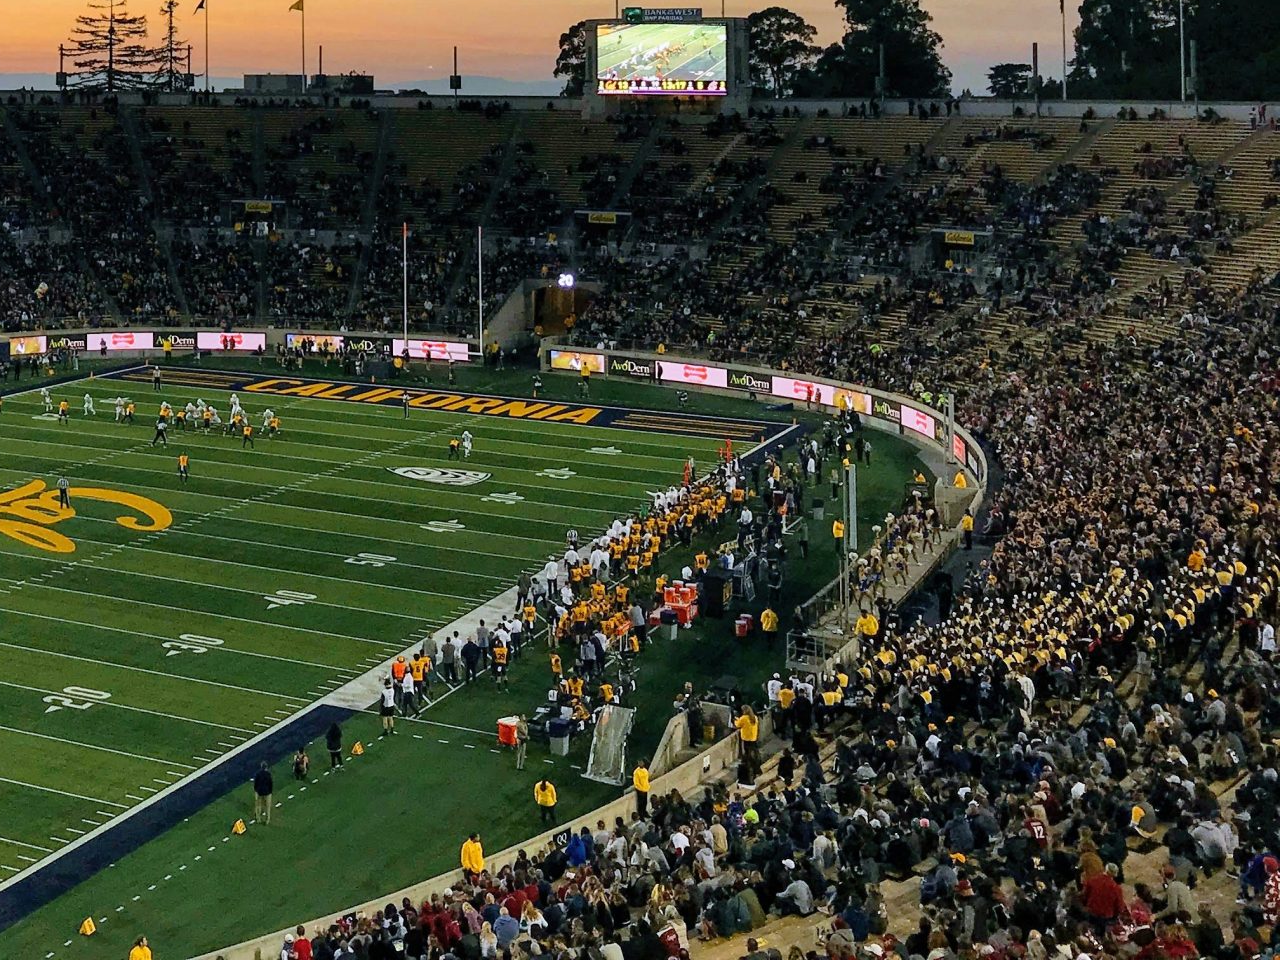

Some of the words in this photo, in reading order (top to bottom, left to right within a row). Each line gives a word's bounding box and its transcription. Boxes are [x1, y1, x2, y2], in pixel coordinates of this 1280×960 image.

[558, 273, 574, 287] 20
[242, 378, 603, 424] CALIFORNIA
[344, 551, 398, 567] 50
[263, 589, 318, 606] 40
[161, 633, 225, 654] 30
[42, 686, 112, 711] 20
[1033, 824, 1045, 839] 12
